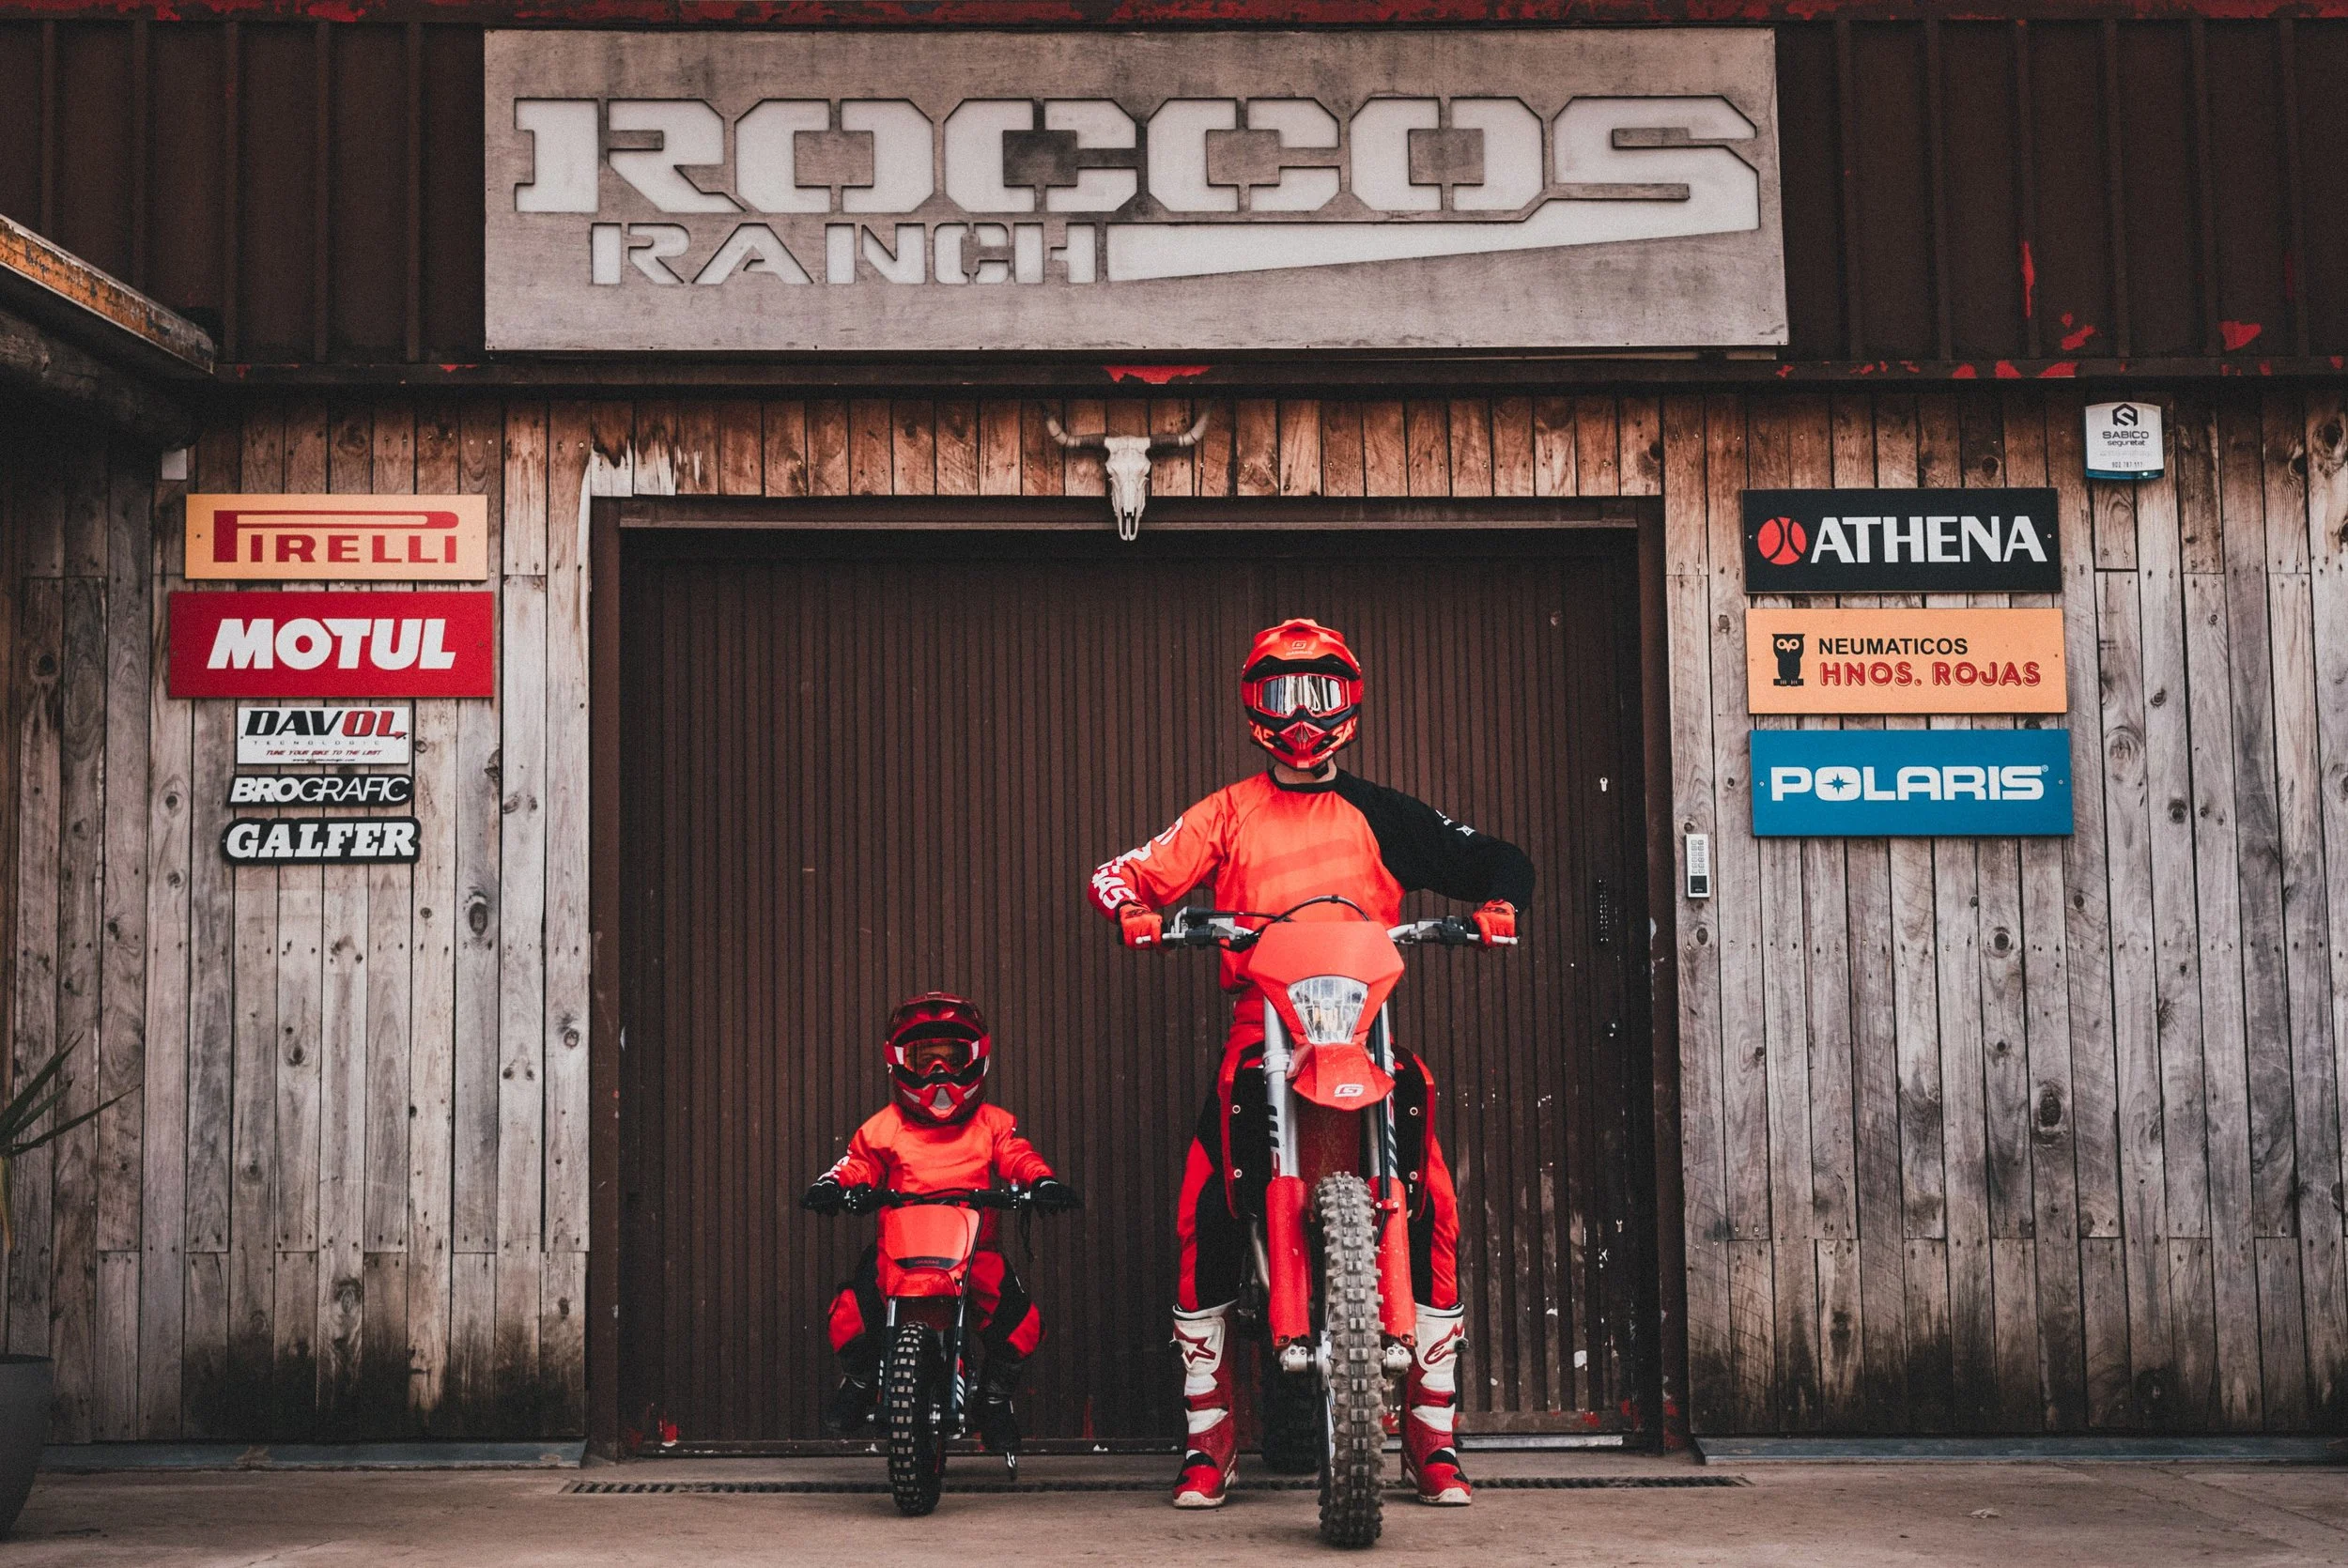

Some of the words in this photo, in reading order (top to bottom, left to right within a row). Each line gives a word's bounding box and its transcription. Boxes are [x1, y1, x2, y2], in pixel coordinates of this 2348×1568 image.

[514, 96, 1761, 230] ROCCOS
[591, 222, 1098, 285] RANCH
[2102, 430, 2150, 439] SABICO
[2107, 439, 2145, 448] seguretat
[213, 510, 459, 563] PIRELLI
[1810, 515, 2047, 563] ATHENA
[207, 618, 456, 670] MOTUL
[1818, 638, 1969, 655] NEUMATICOS
[1819, 661, 1923, 687] HNOS.
[1931, 661, 2042, 687] ROJAS
[244, 710, 409, 739] DAVOL
[230, 776, 410, 803] BROGRAFIC
[226, 822, 415, 858] GALFER
